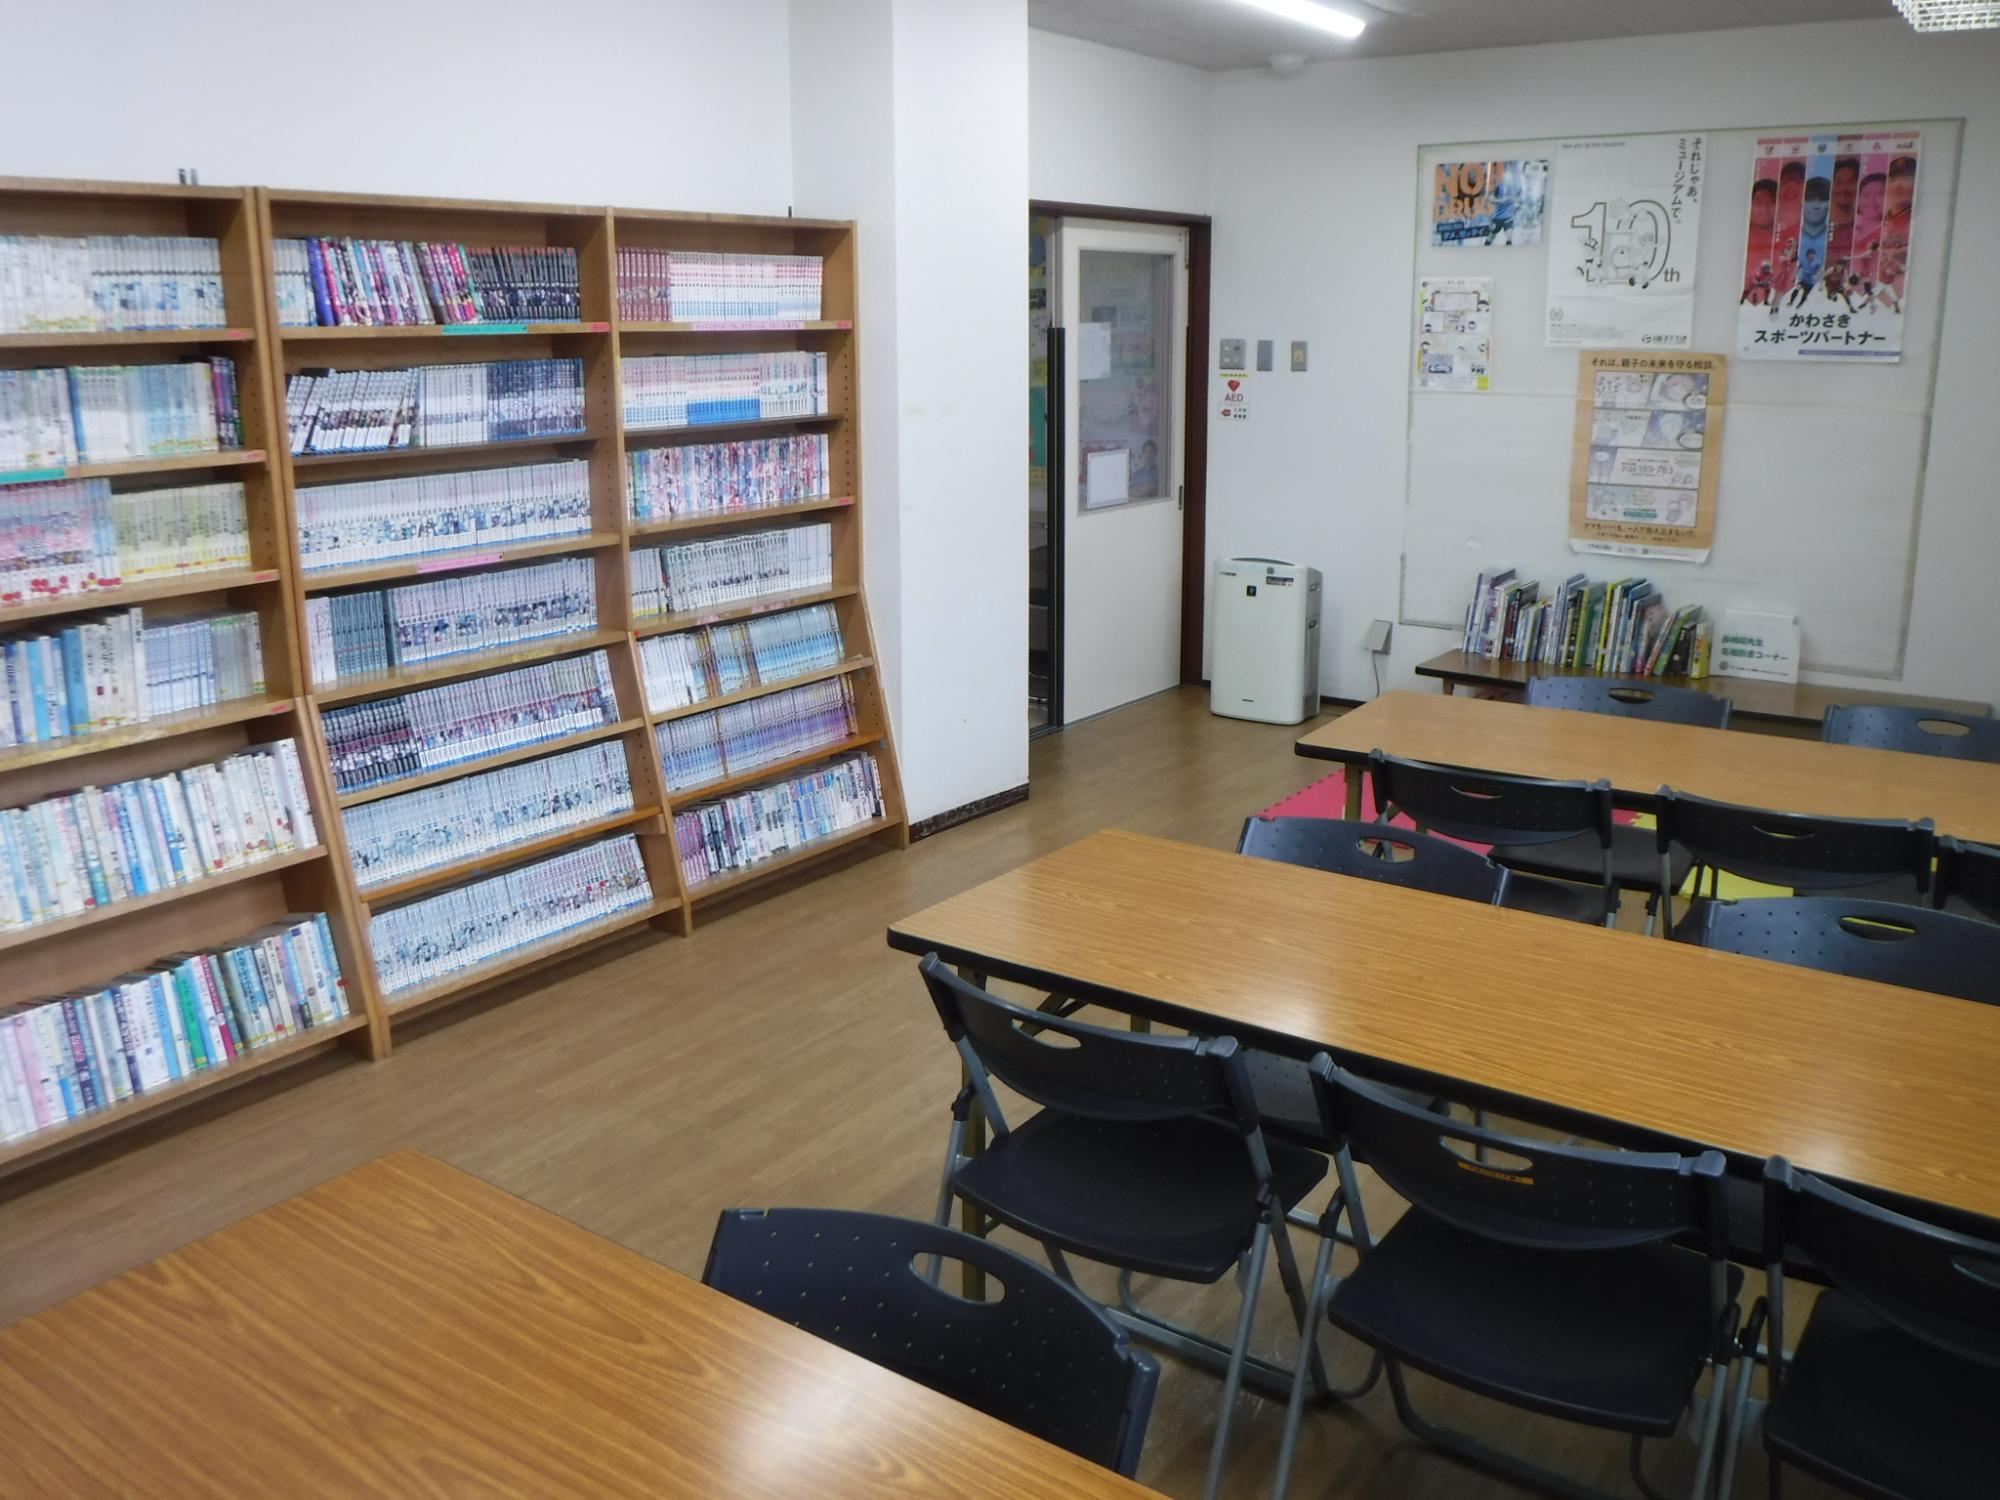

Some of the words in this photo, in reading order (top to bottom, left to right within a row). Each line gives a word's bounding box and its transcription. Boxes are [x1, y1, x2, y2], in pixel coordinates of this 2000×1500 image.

[1788, 313, 1852, 328] かわさき
[1753, 329, 1887, 345] スポーツパートナー
[1224, 393, 1244, 402] AED
